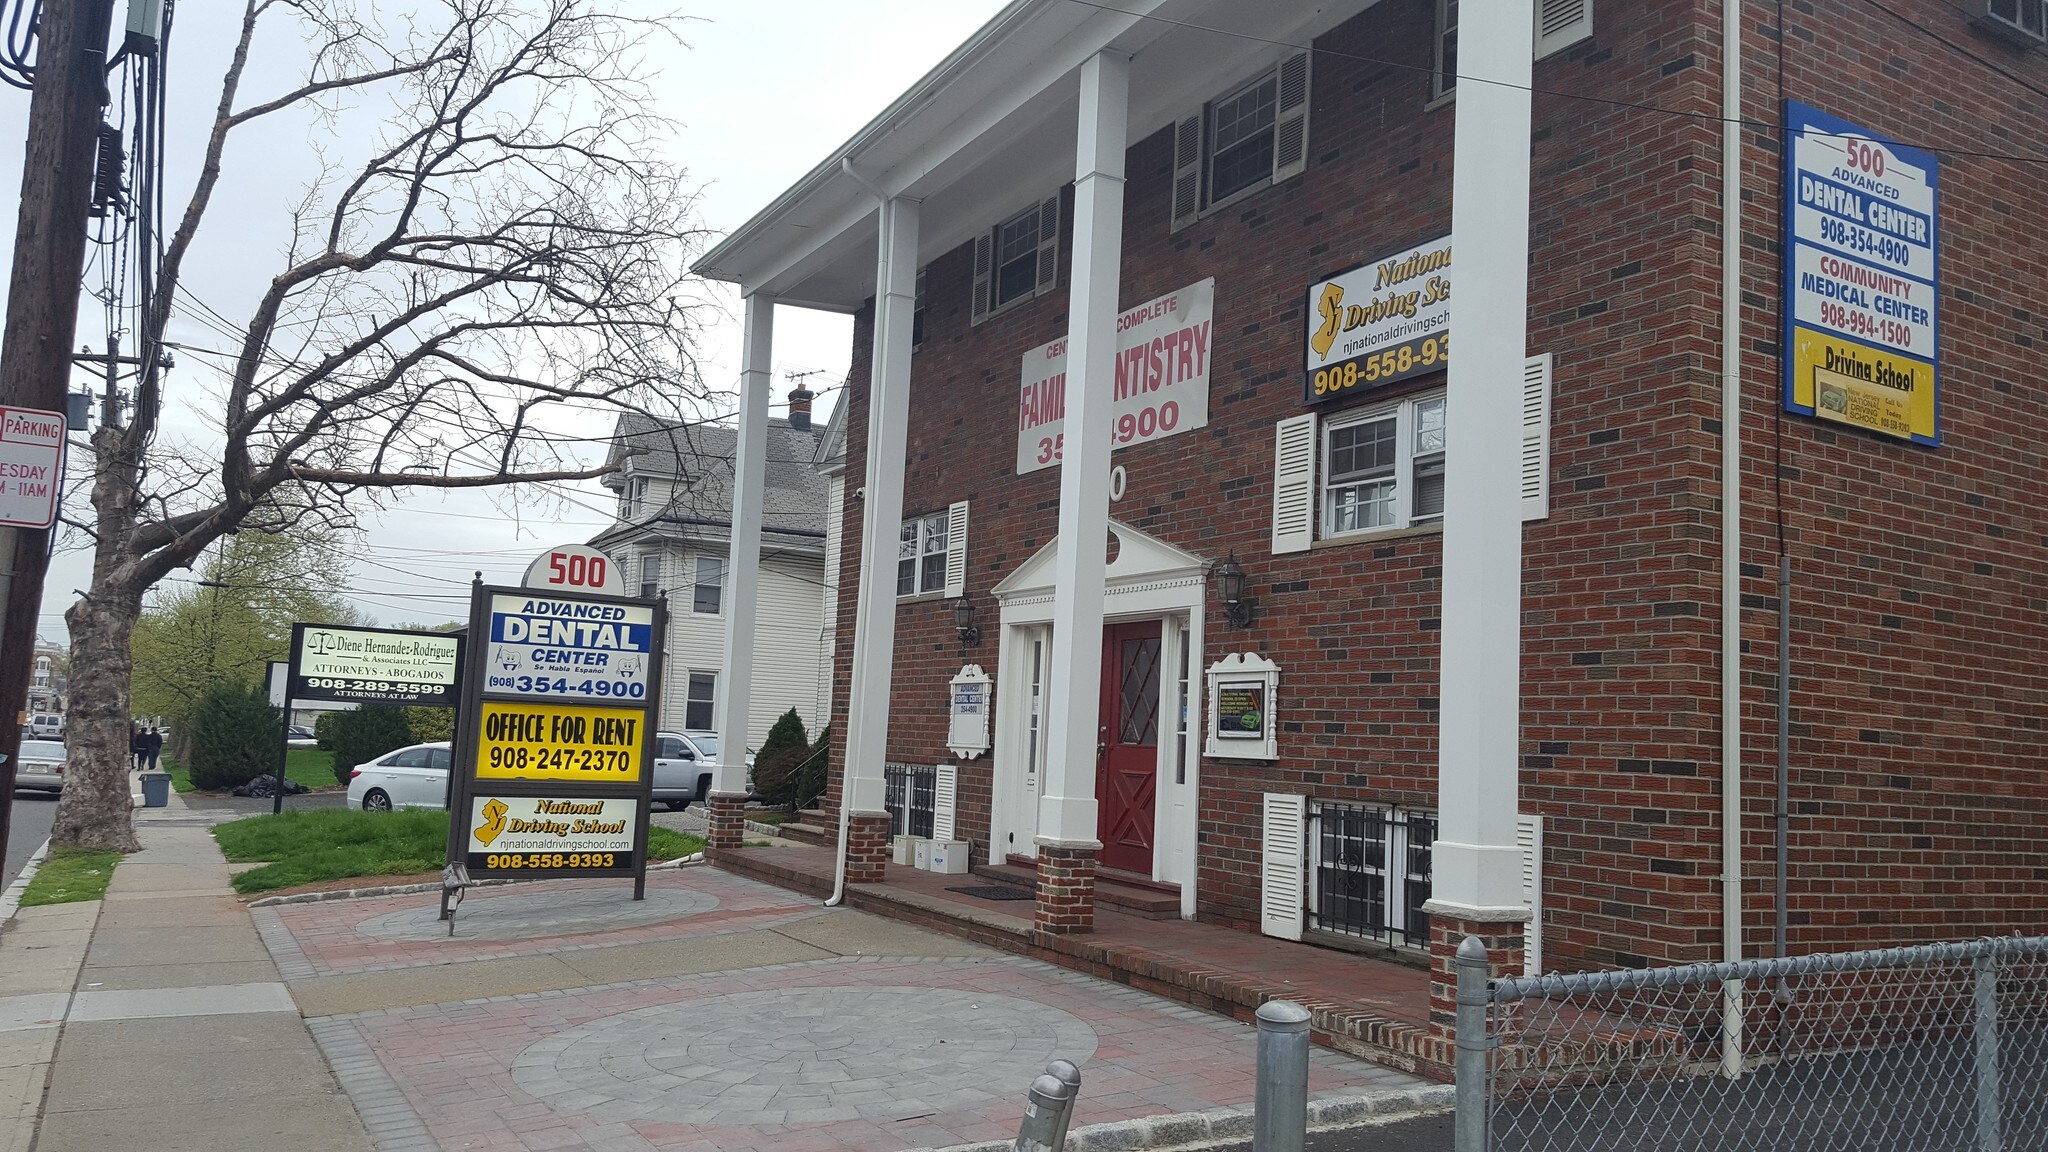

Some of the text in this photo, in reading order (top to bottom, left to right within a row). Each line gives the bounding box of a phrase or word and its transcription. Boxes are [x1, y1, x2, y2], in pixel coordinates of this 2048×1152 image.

[1847, 138, 1884, 177] 500
[1832, 166, 1900, 200] ADVANCED
[1802, 176, 1926, 243] DENTAL CENTER
[1820, 216, 1909, 266] 908-354-4900
[1820, 256, 1911, 300] COMMUNITY
[1801, 272, 1929, 327] MEDICAL CENTER
[1342, 290, 1420, 332] Driving
[1046, 296, 1178, 360] CEN COMPLETE
[1344, 310, 1450, 355] njnationaldrivingsch
[1820, 301, 1910, 348] 908-994-1500
[1876, 360, 1914, 392] School
[1848, 394, 1880, 410] NATIONAL
[1850, 404, 1878, 417] DRIVING
[1850, 410, 1878, 426] SCHOOL
[1886, 409, 1902, 420] Today
[6, 418, 59, 438] PARKING
[18, 482, 47, 498] 11AM
[548, 552, 606, 588] 500
[521, 600, 626, 620] ADVANCED
[502, 616, 640, 650] DENTAL
[337, 636, 454, 660] Diene Hernandez-Rodriguez
[531, 648, 609, 666] CENTER
[372, 656, 410, 665] Associates
[413, 658, 428, 666] LLC
[574, 666, 604, 674] Español
[312, 664, 378, 676] ATTORNEYS
[385, 668, 444, 680] ABOGADOS
[308, 678, 445, 694] 908-289-5599
[334, 690, 386, 698] ATTORNEYS
[489, 675, 644, 698] (908) 354-4900
[486, 712, 636, 746] OFFICE FOR RENT
[490, 746, 630, 772] 908-247-2370
[535, 800, 603, 816] National
[508, 819, 625, 837] Driving School
[500, 838, 629, 850] njnationaldrivingschool.com
[486, 854, 614, 869] 908-558-9393
